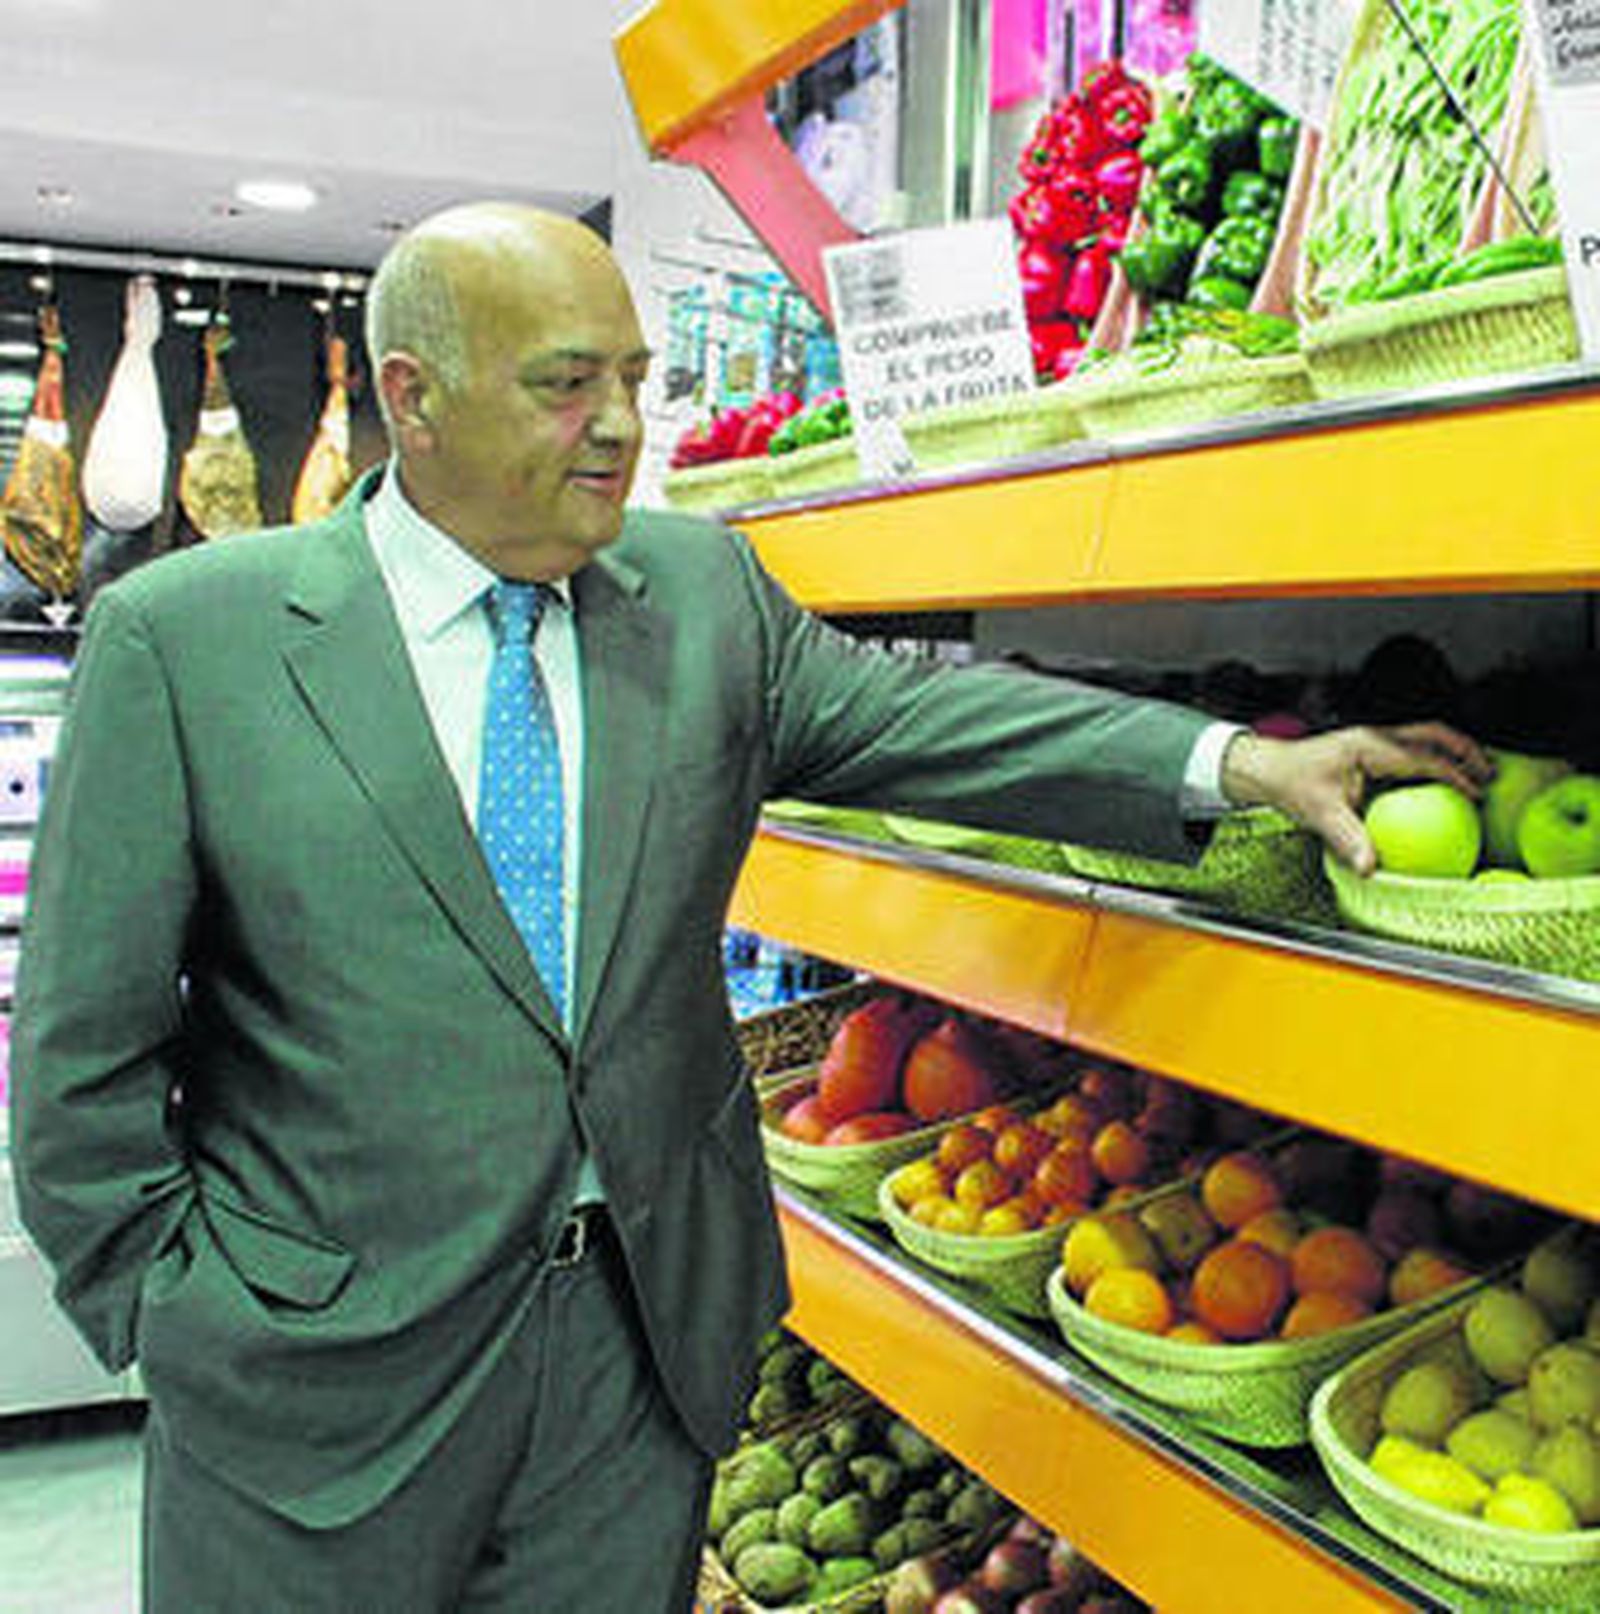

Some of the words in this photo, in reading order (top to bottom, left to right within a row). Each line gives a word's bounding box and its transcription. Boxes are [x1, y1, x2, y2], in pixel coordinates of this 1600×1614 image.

[887, 361, 917, 383] EL
[925, 346, 995, 376] PESO
[862, 397, 895, 420] DE
